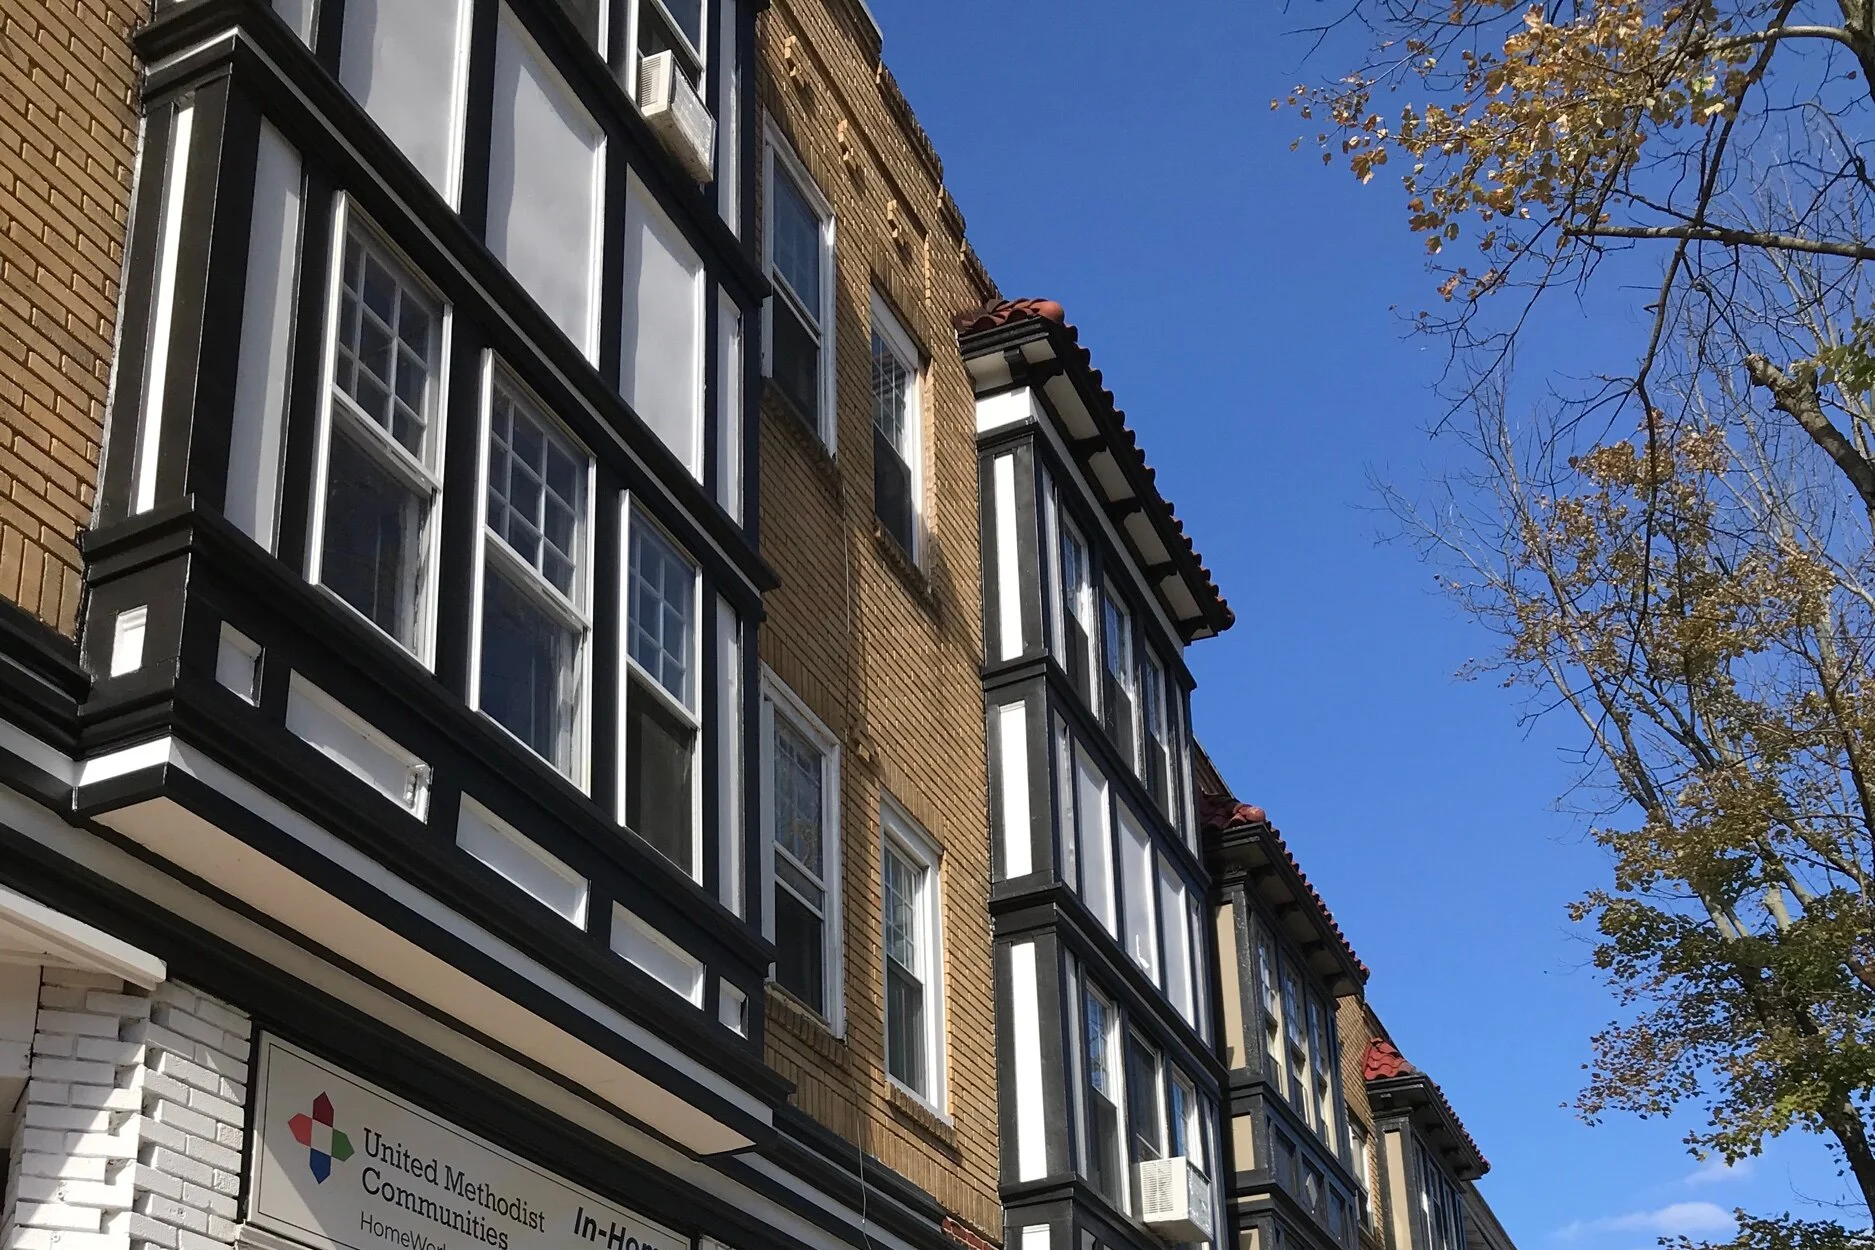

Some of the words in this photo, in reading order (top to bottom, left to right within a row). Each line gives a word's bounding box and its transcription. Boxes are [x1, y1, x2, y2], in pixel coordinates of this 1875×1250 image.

[361, 1167, 509, 1250] Communities
[363, 1127, 438, 1186] United
[443, 1164, 546, 1233] Methodist
